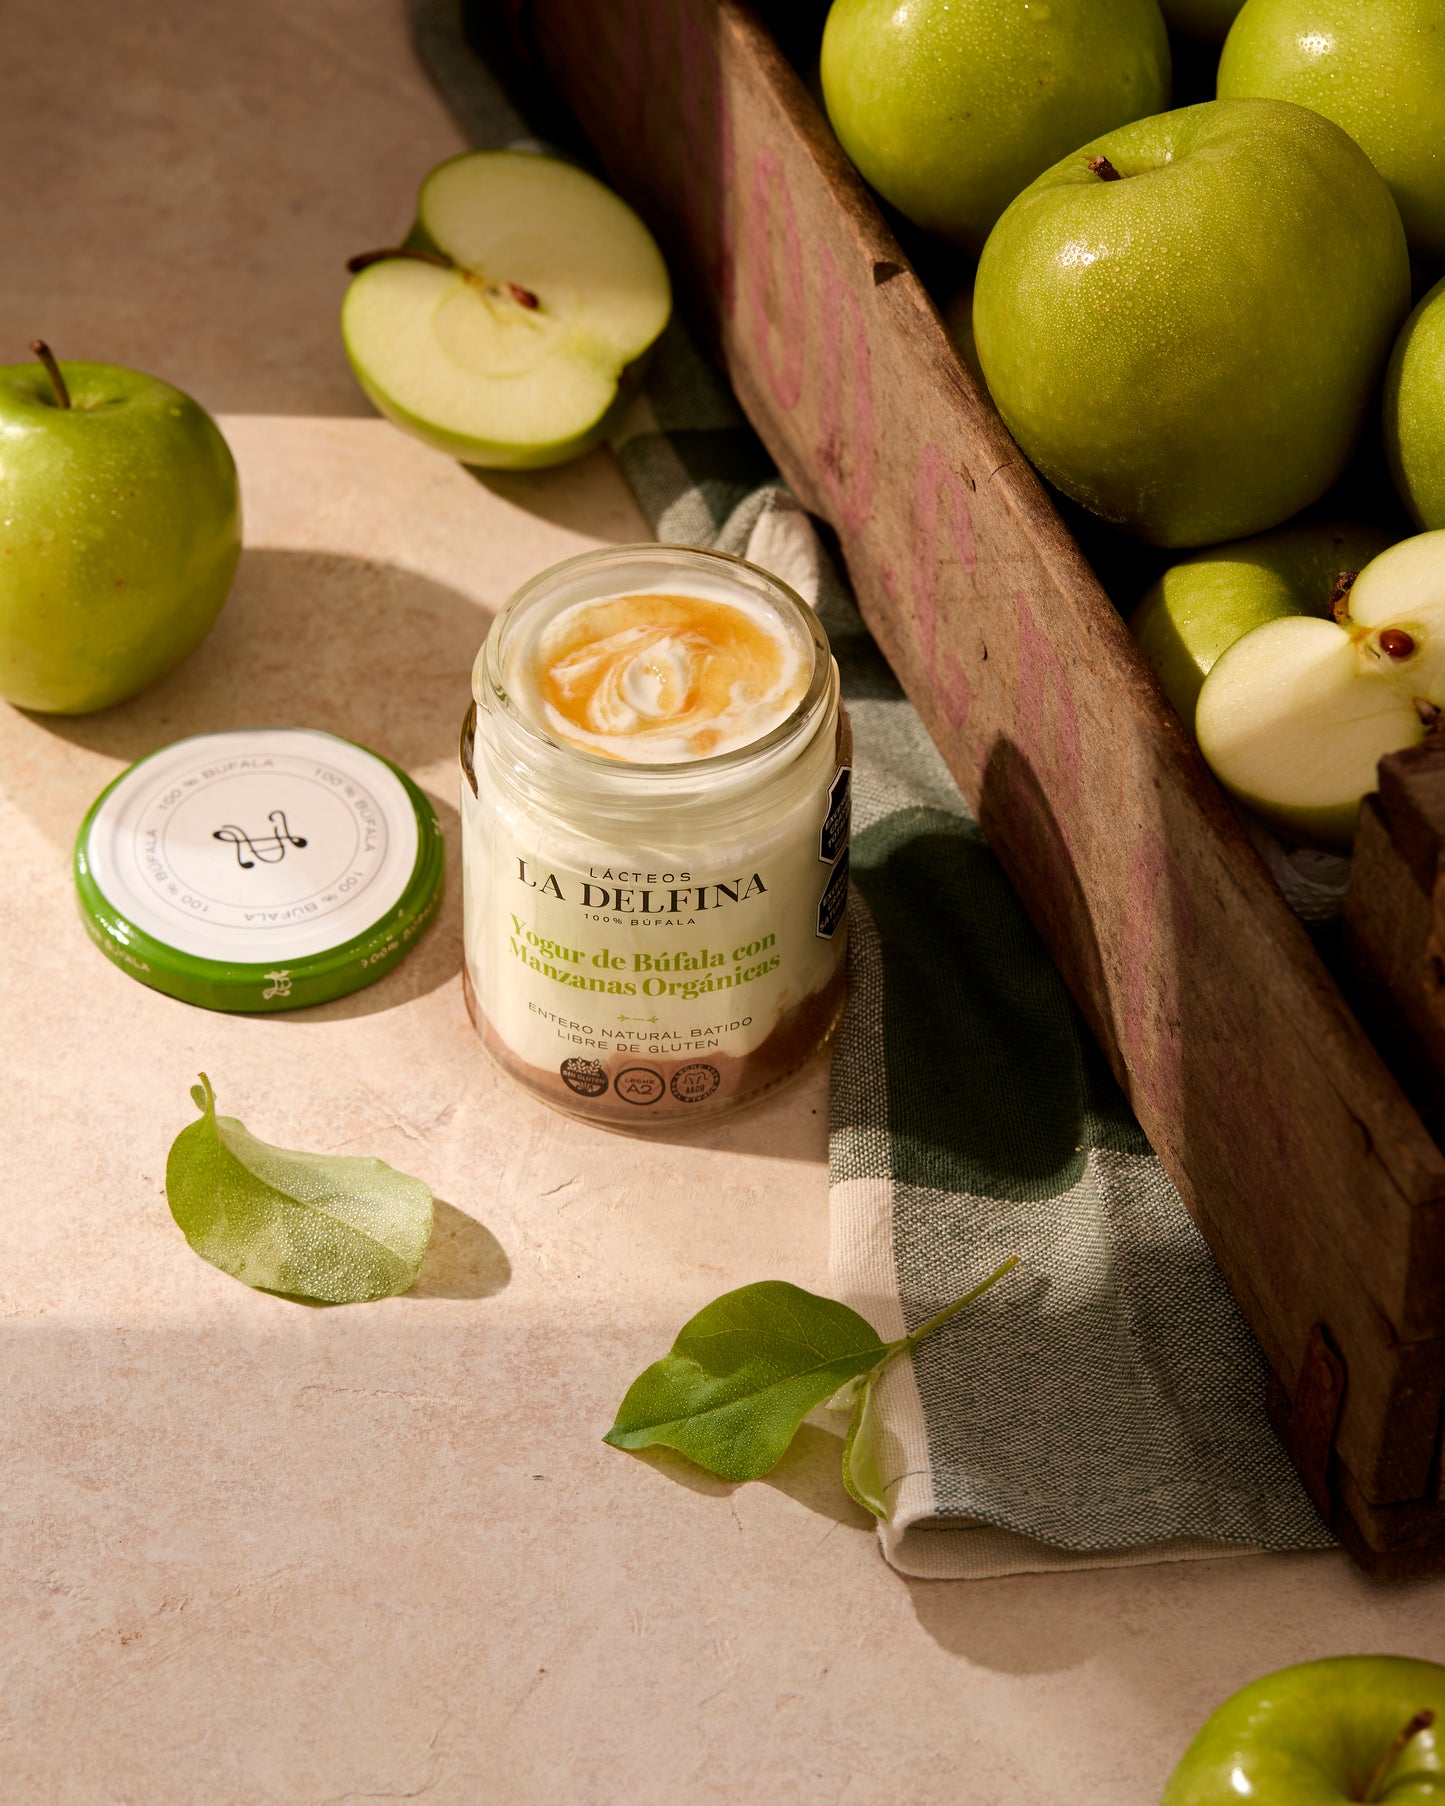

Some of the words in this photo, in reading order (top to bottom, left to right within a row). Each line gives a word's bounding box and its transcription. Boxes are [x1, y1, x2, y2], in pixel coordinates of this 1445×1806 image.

[158, 788, 183, 811] 100
[184, 779, 199, 789] %
[315, 768, 342, 787] 100
[344, 786, 357, 799] %
[339, 871, 365, 893] 100
[516, 857, 566, 901] LA
[579, 872, 768, 913] DELFINA
[589, 867, 691, 884] LÁCTEOS
[180, 895, 209, 913] 100
[585, 913, 623, 925] 100%
[630, 917, 696, 926] BÚFALA
[510, 912, 586, 959] Yogur
[592, 948, 627, 970] de
[633, 949, 726, 972] Búfala
[732, 932, 777, 962] con
[509, 935, 637, 997] Manzanas
[642, 953, 781, 1000] Orgánicas
[528, 1001, 594, 1034] ENTERO
[602, 1028, 682, 1041] NATURAL
[690, 1016, 753, 1038] BATIDO
[557, 1029, 608, 1050] LIBRE
[617, 1042, 640, 1053] DE
[648, 1038, 719, 1054] GLUTEN
[624, 1077, 655, 1085] LECHE
[626, 1084, 652, 1095] A2
